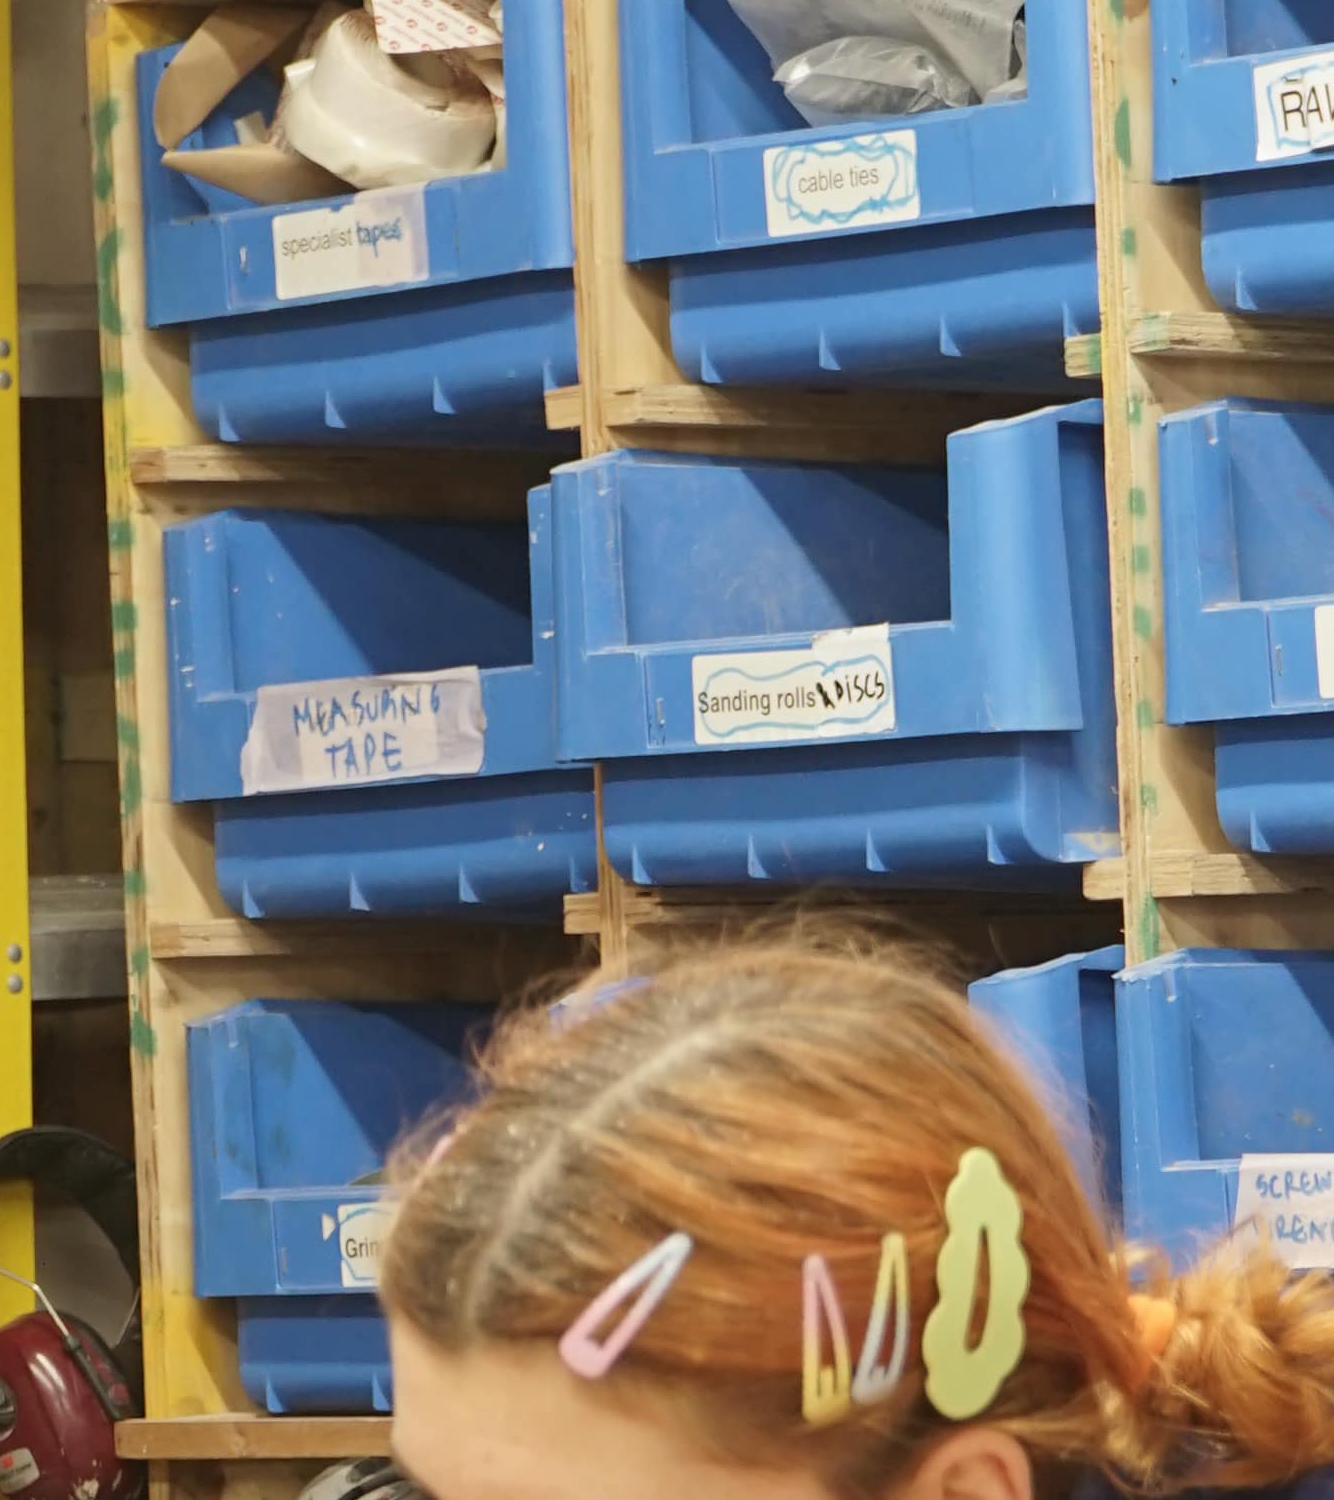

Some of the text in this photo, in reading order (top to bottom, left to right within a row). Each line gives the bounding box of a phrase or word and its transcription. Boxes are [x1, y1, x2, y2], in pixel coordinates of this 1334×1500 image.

[798, 165, 880, 194] cable ties
[281, 226, 354, 260] specialist
[697, 688, 771, 717] Sanding
[776, 686, 817, 709] rolls
[324, 730, 403, 780] TAPE
